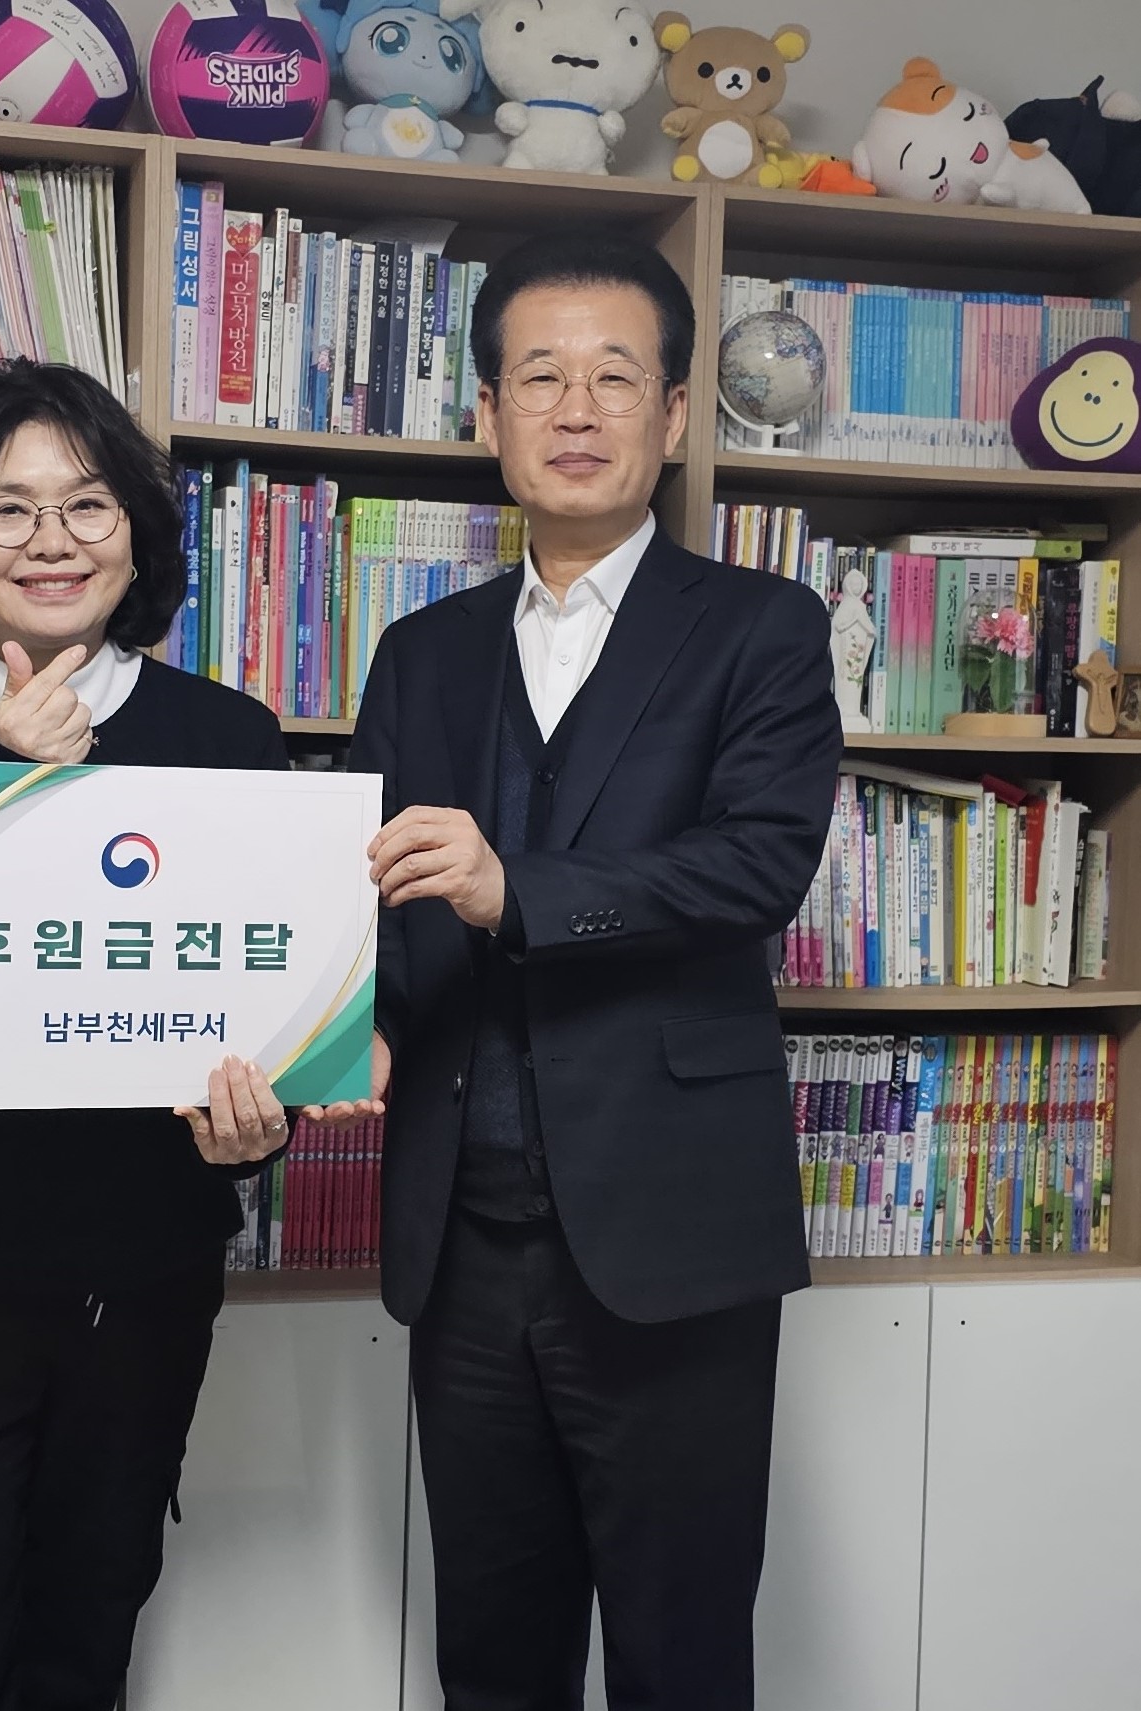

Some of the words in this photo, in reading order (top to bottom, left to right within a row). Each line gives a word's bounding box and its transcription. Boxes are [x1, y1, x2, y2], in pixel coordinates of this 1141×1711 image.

[207, 54, 300, 85] SPIDERS
[230, 84, 285, 106] PINK
[180, 207, 200, 302] 그림성서
[378, 254, 389, 289] 다정한
[396, 255, 408, 290] 다정한
[227, 260, 253, 371] 마음처방전
[377, 295, 388, 319] 겨울
[395, 296, 406, 320] 겨울
[43, 1012, 227, 1043] 남부천세무서
[891, 1058, 906, 1100] Why?
[920, 1067, 935, 1108] Why?
[795, 1086, 809, 1128] Why?
